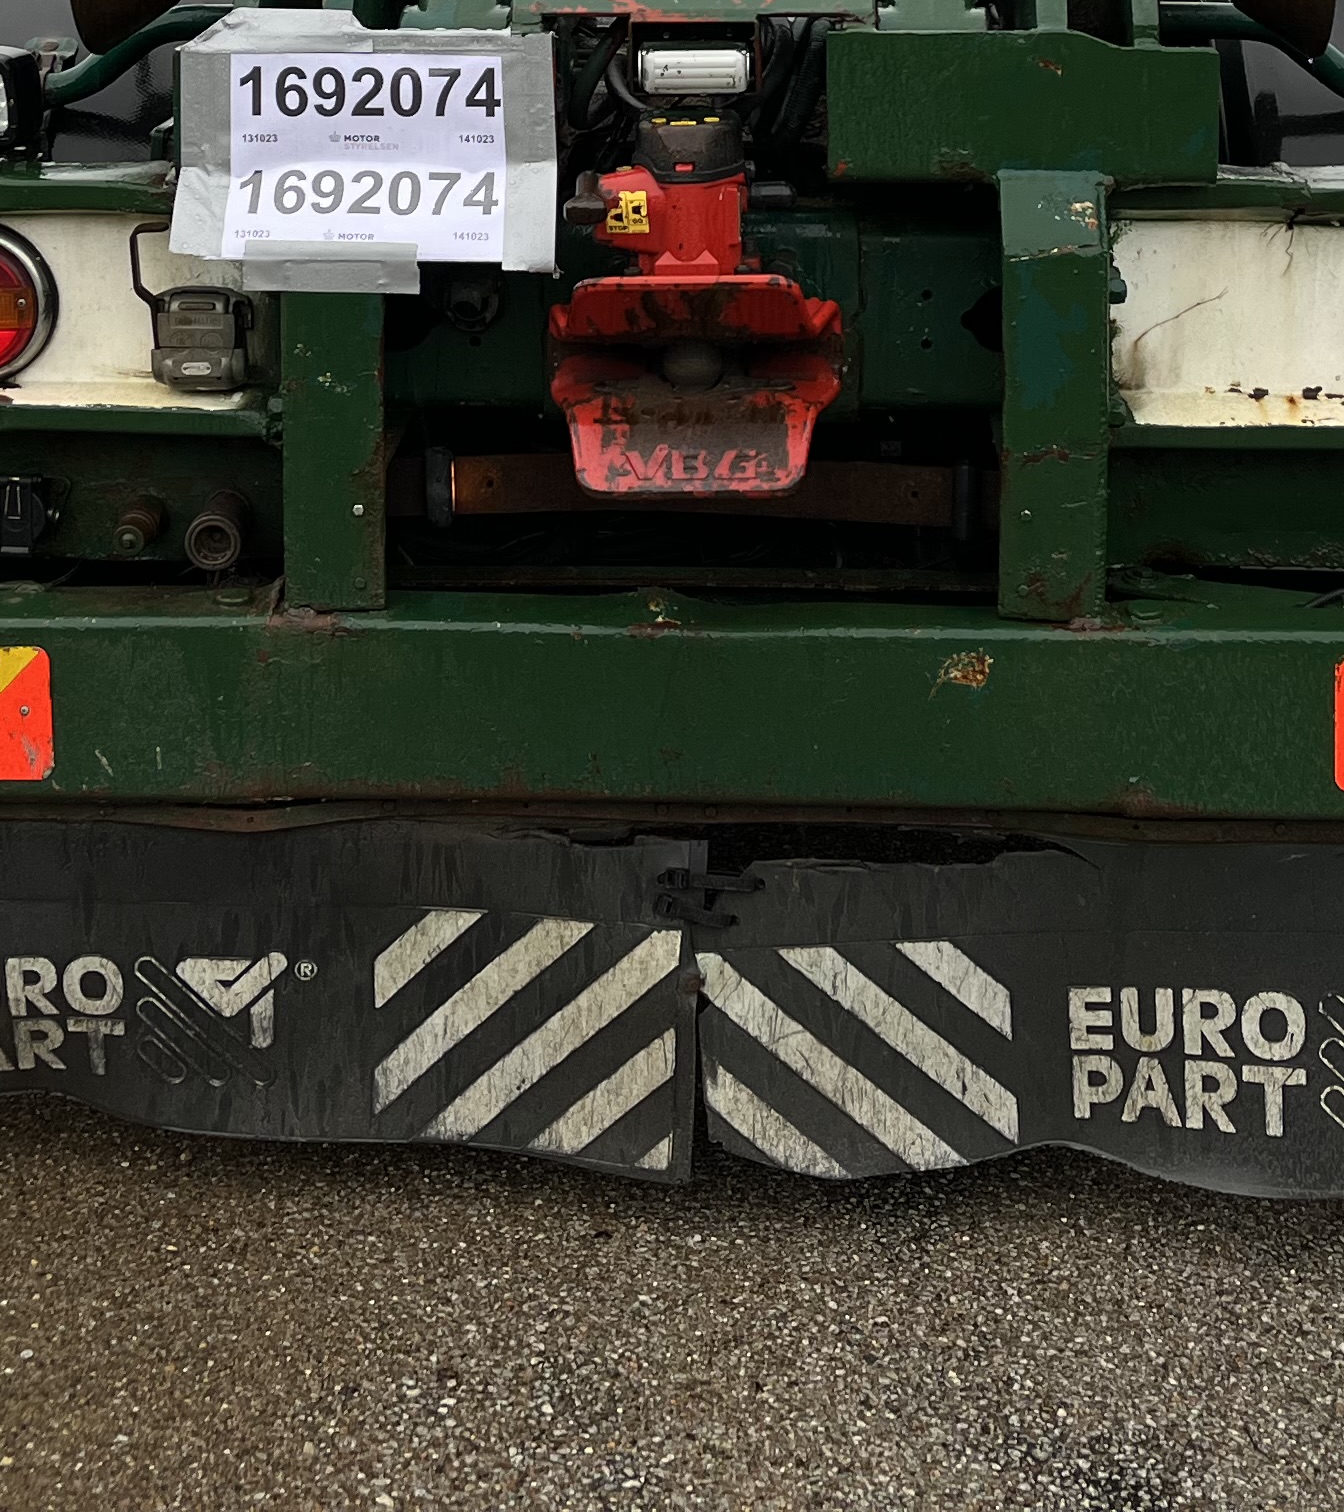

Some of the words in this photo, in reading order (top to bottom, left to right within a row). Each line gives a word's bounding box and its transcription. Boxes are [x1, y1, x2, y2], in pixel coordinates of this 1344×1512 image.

[239, 65, 501, 118] 1692074
[241, 133, 278, 143] 131023
[343, 134, 380, 143] MOTOR
[458, 134, 495, 144] 141023
[343, 143, 399, 151] STYRELSEN
[239, 169, 499, 216] 1692074
[234, 229, 271, 239] 131023
[337, 233, 375, 241] MOTOR
[453, 231, 489, 241] 141023
[1068, 986, 1306, 1060] EURO
[1071, 1054, 1306, 1137] PART
